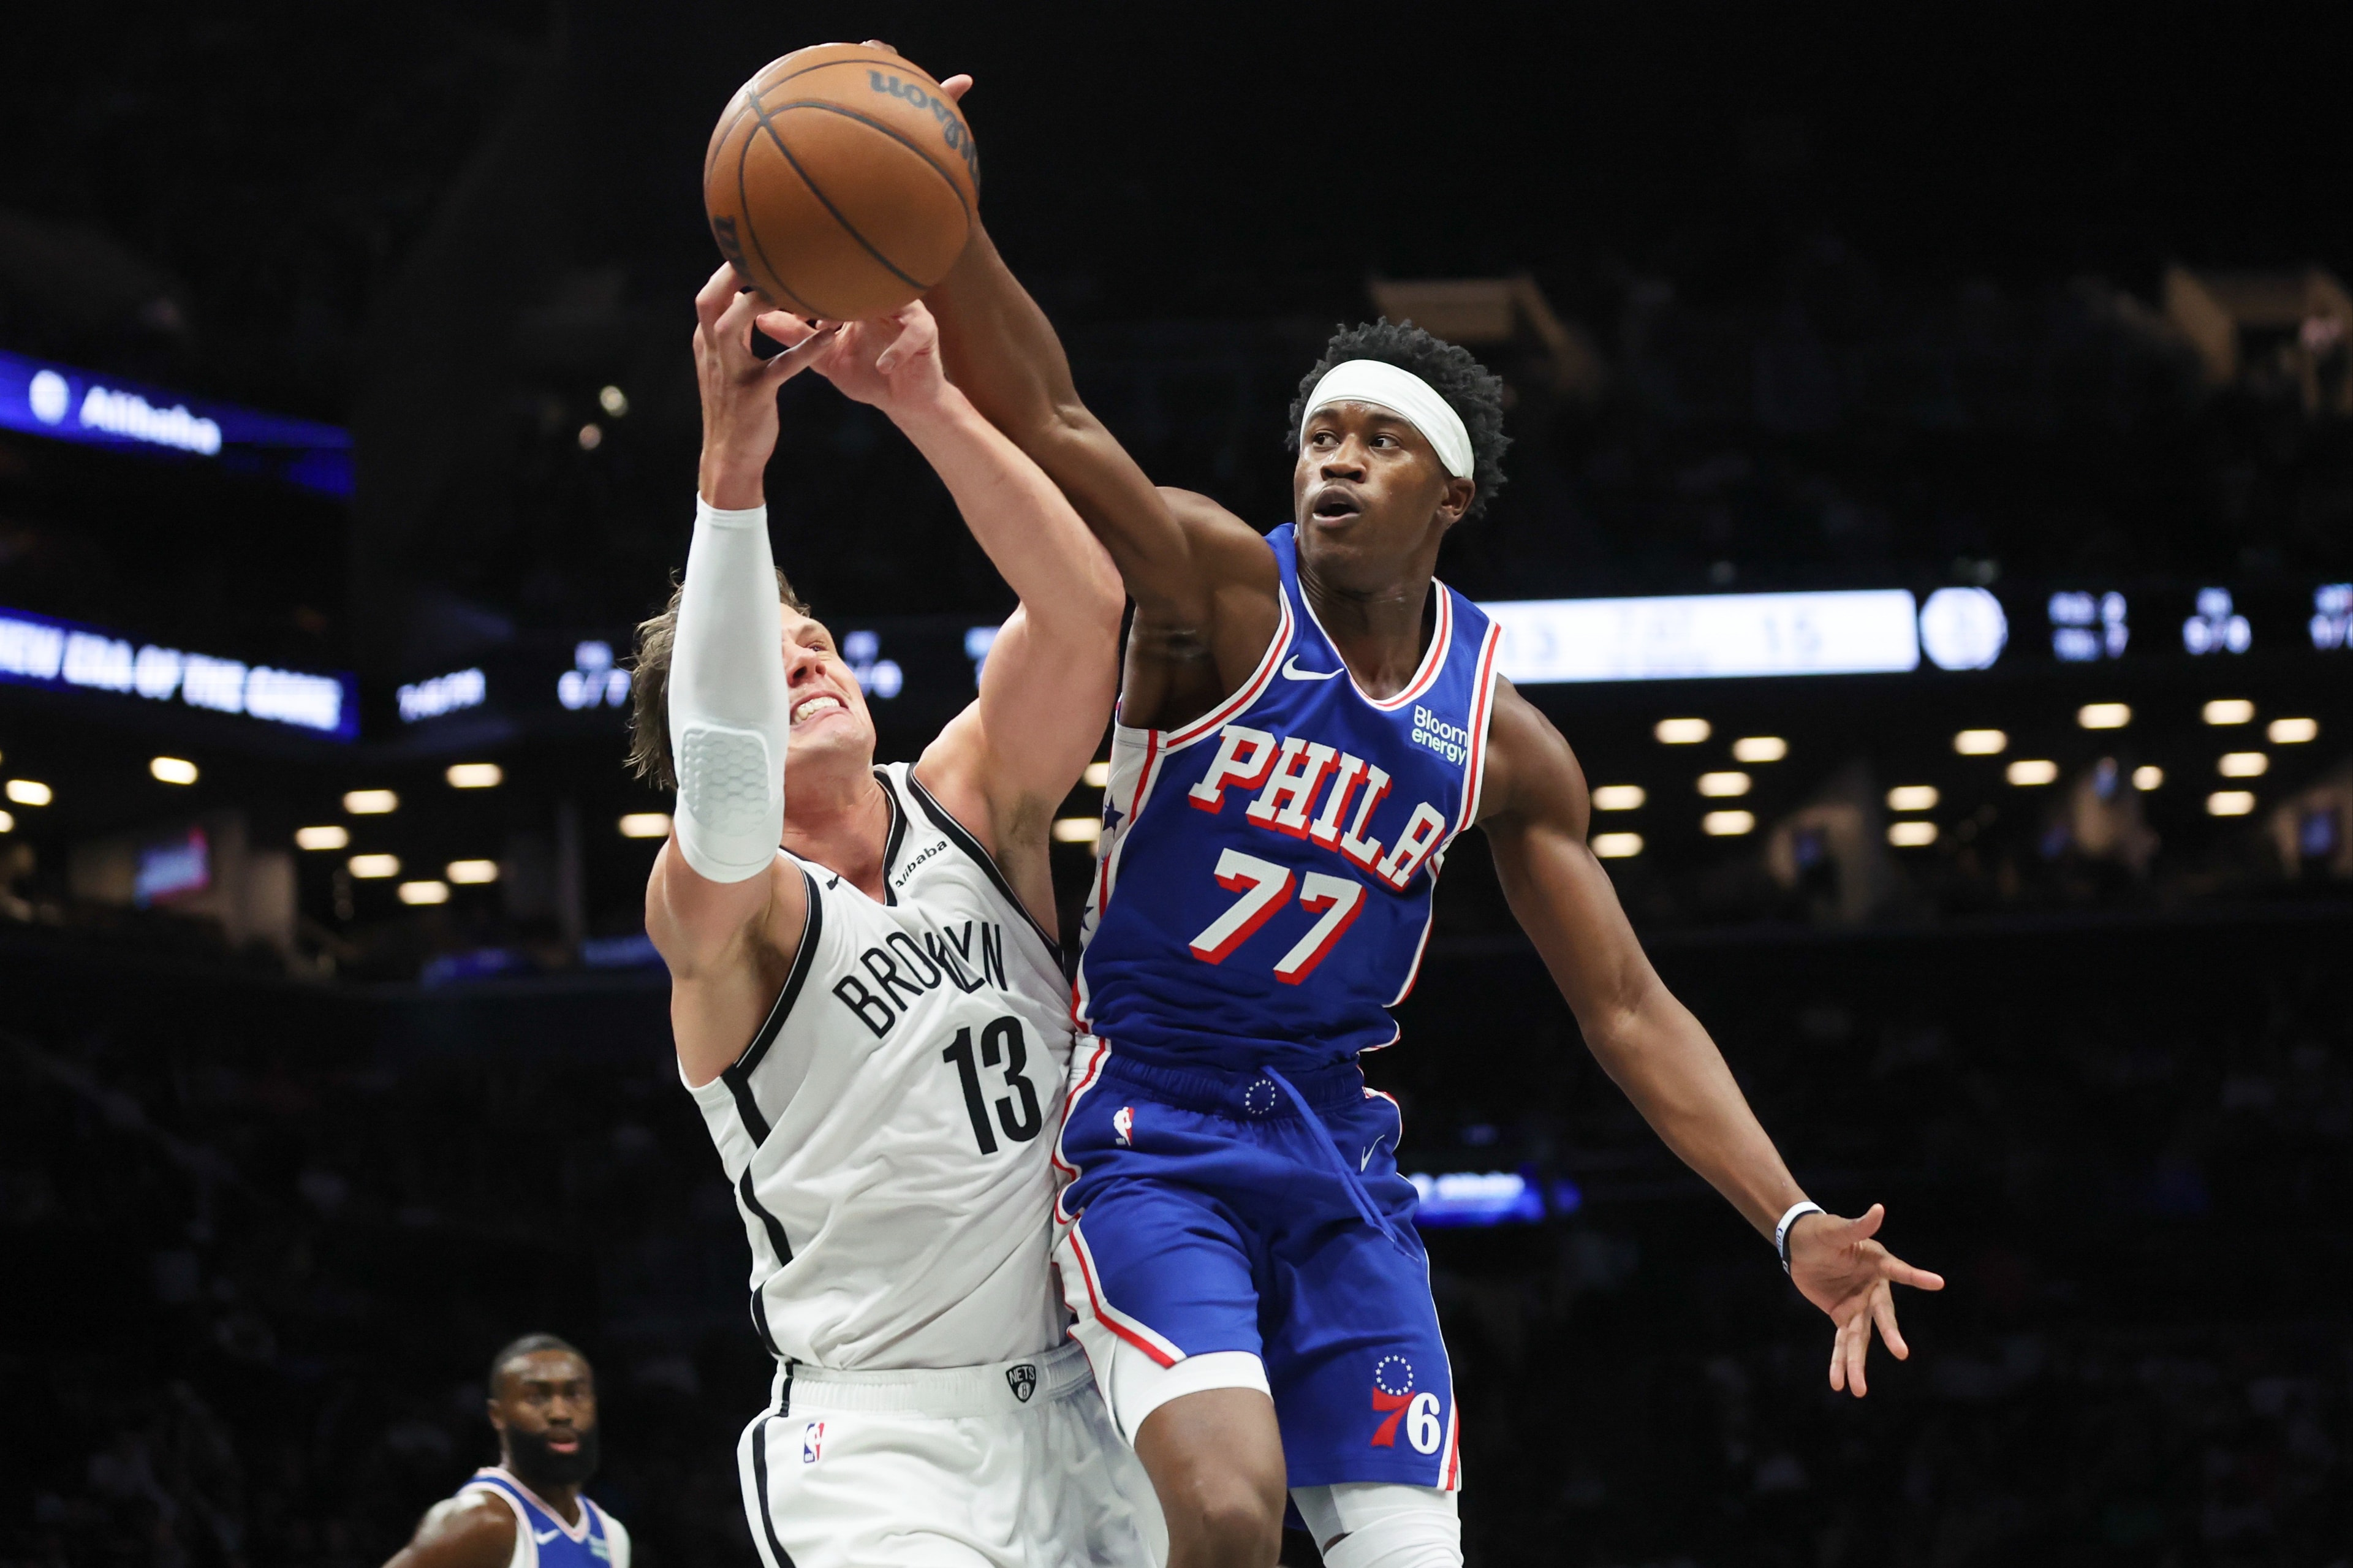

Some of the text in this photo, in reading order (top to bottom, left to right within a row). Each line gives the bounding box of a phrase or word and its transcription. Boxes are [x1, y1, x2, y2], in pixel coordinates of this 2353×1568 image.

[1412, 728, 1467, 766] energy
[1414, 705, 1468, 748] Bloom
[1188, 724, 1446, 892] PHILA
[1189, 847, 1368, 986] 77
[942, 1015, 1042, 1156] 13
[1009, 1366, 1036, 1385] NETS
[1370, 1386, 1441, 1455] 76
